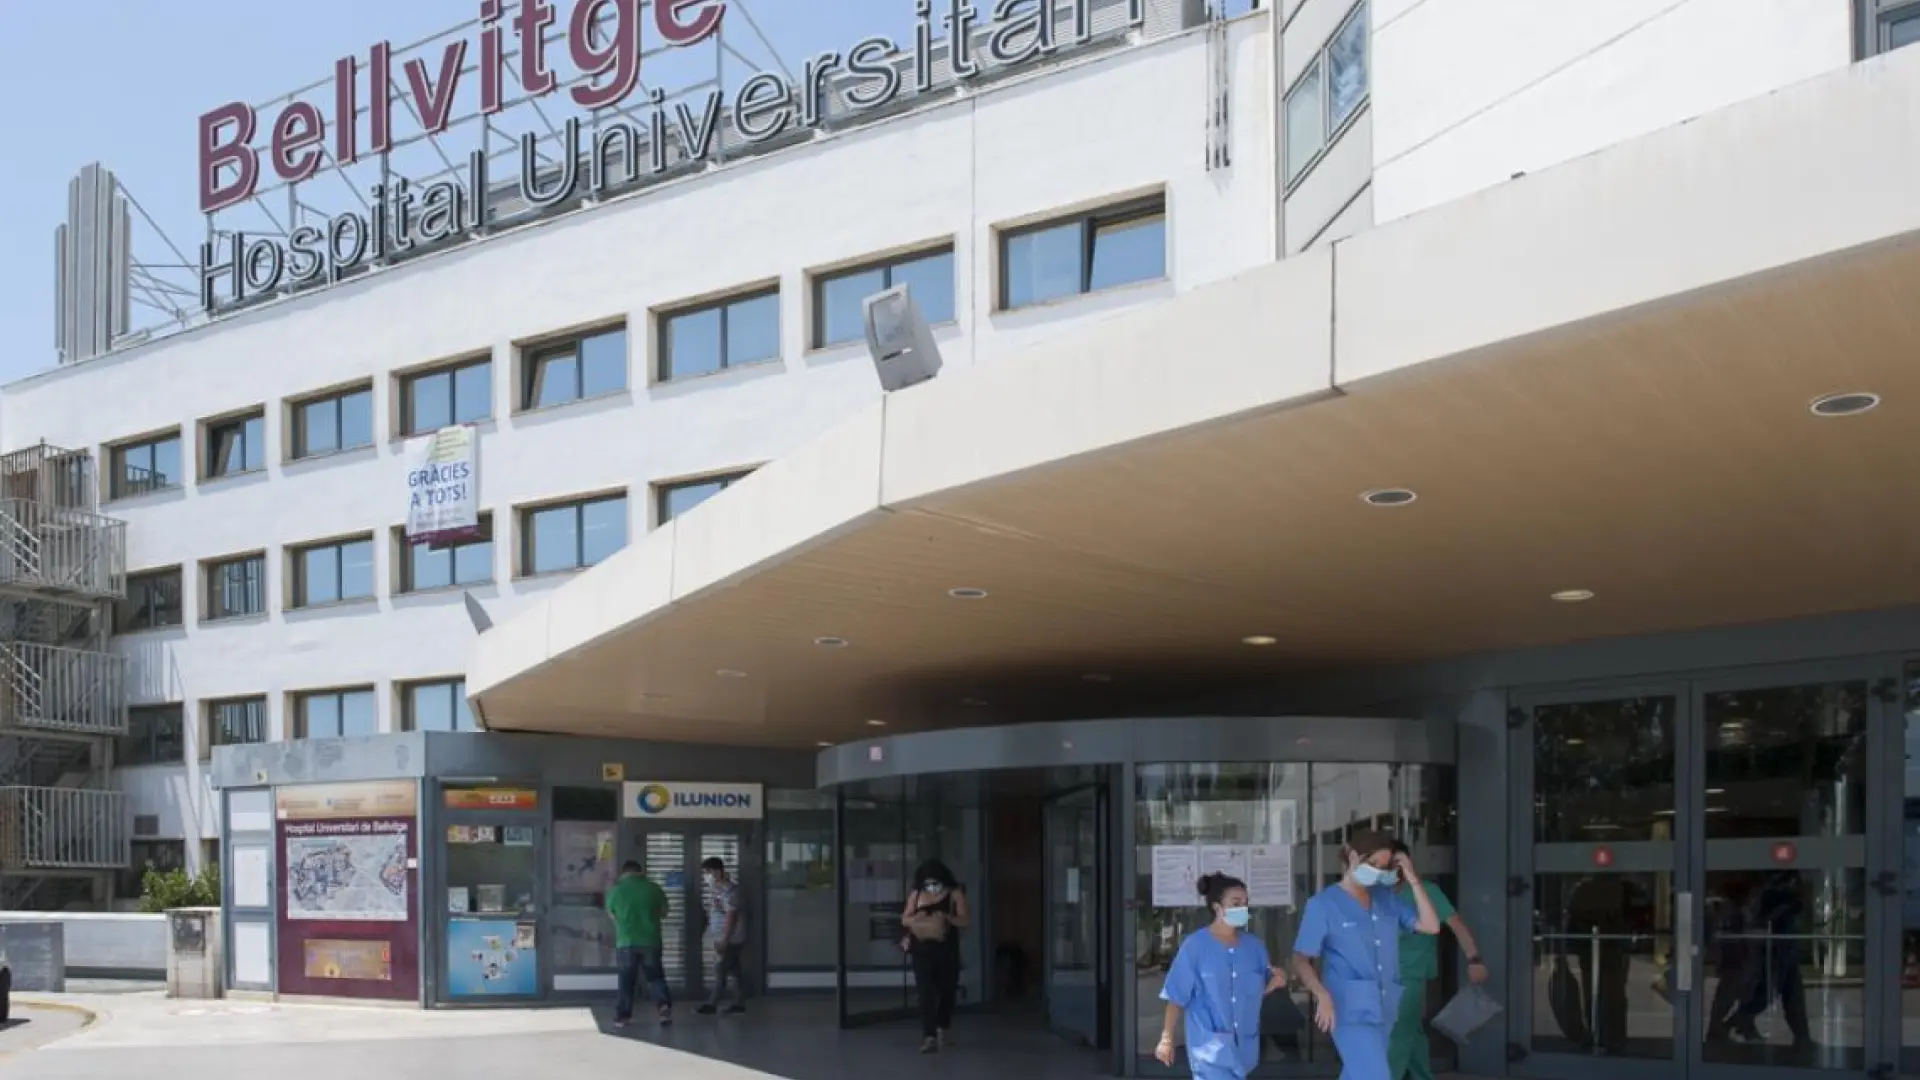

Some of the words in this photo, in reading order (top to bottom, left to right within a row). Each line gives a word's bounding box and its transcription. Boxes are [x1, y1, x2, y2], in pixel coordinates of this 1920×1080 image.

[200, 149, 484, 312] Hospital
[411, 492, 421, 506] A
[425, 482, 467, 505] TOTS!
[673, 791, 751, 808] ILUNION
[284, 822, 316, 835] Hospital
[360, 821, 372, 833] de
